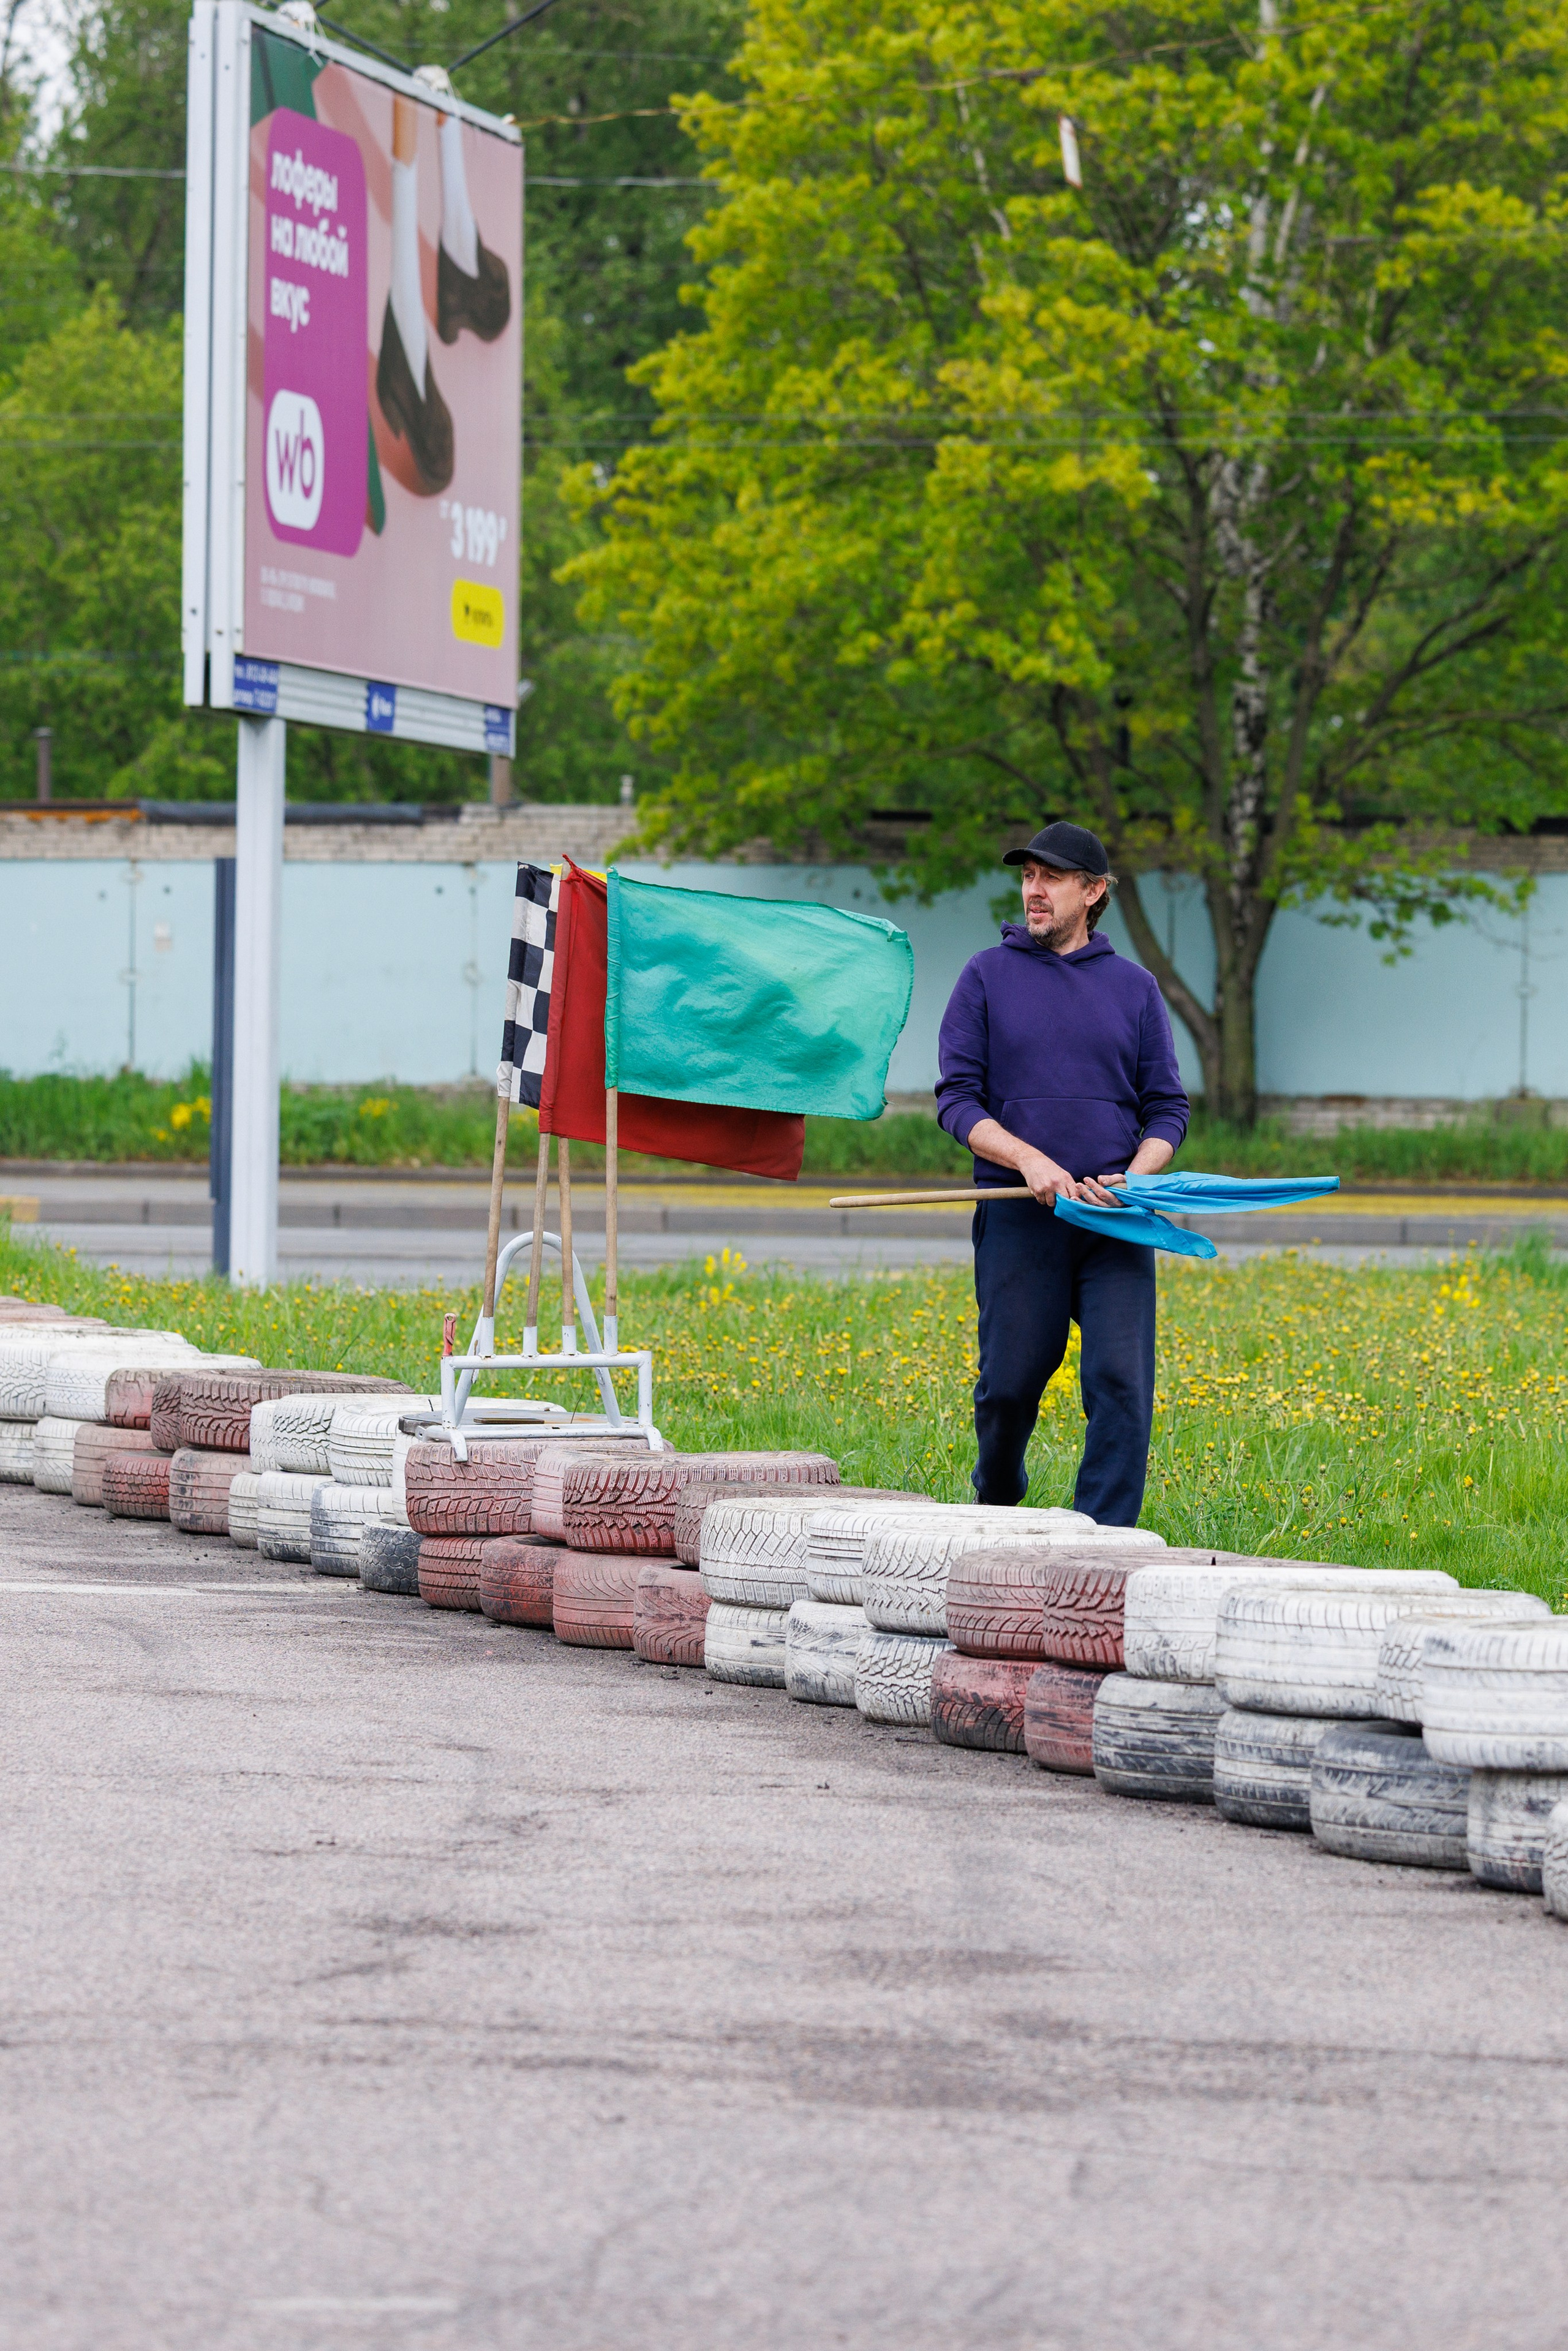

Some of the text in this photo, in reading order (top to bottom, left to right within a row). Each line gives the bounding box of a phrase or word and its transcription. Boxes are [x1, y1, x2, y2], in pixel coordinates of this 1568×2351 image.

[271, 149, 338, 216] лоферы
[271, 215, 349, 278] на любой
[270, 277, 311, 333] вкус
